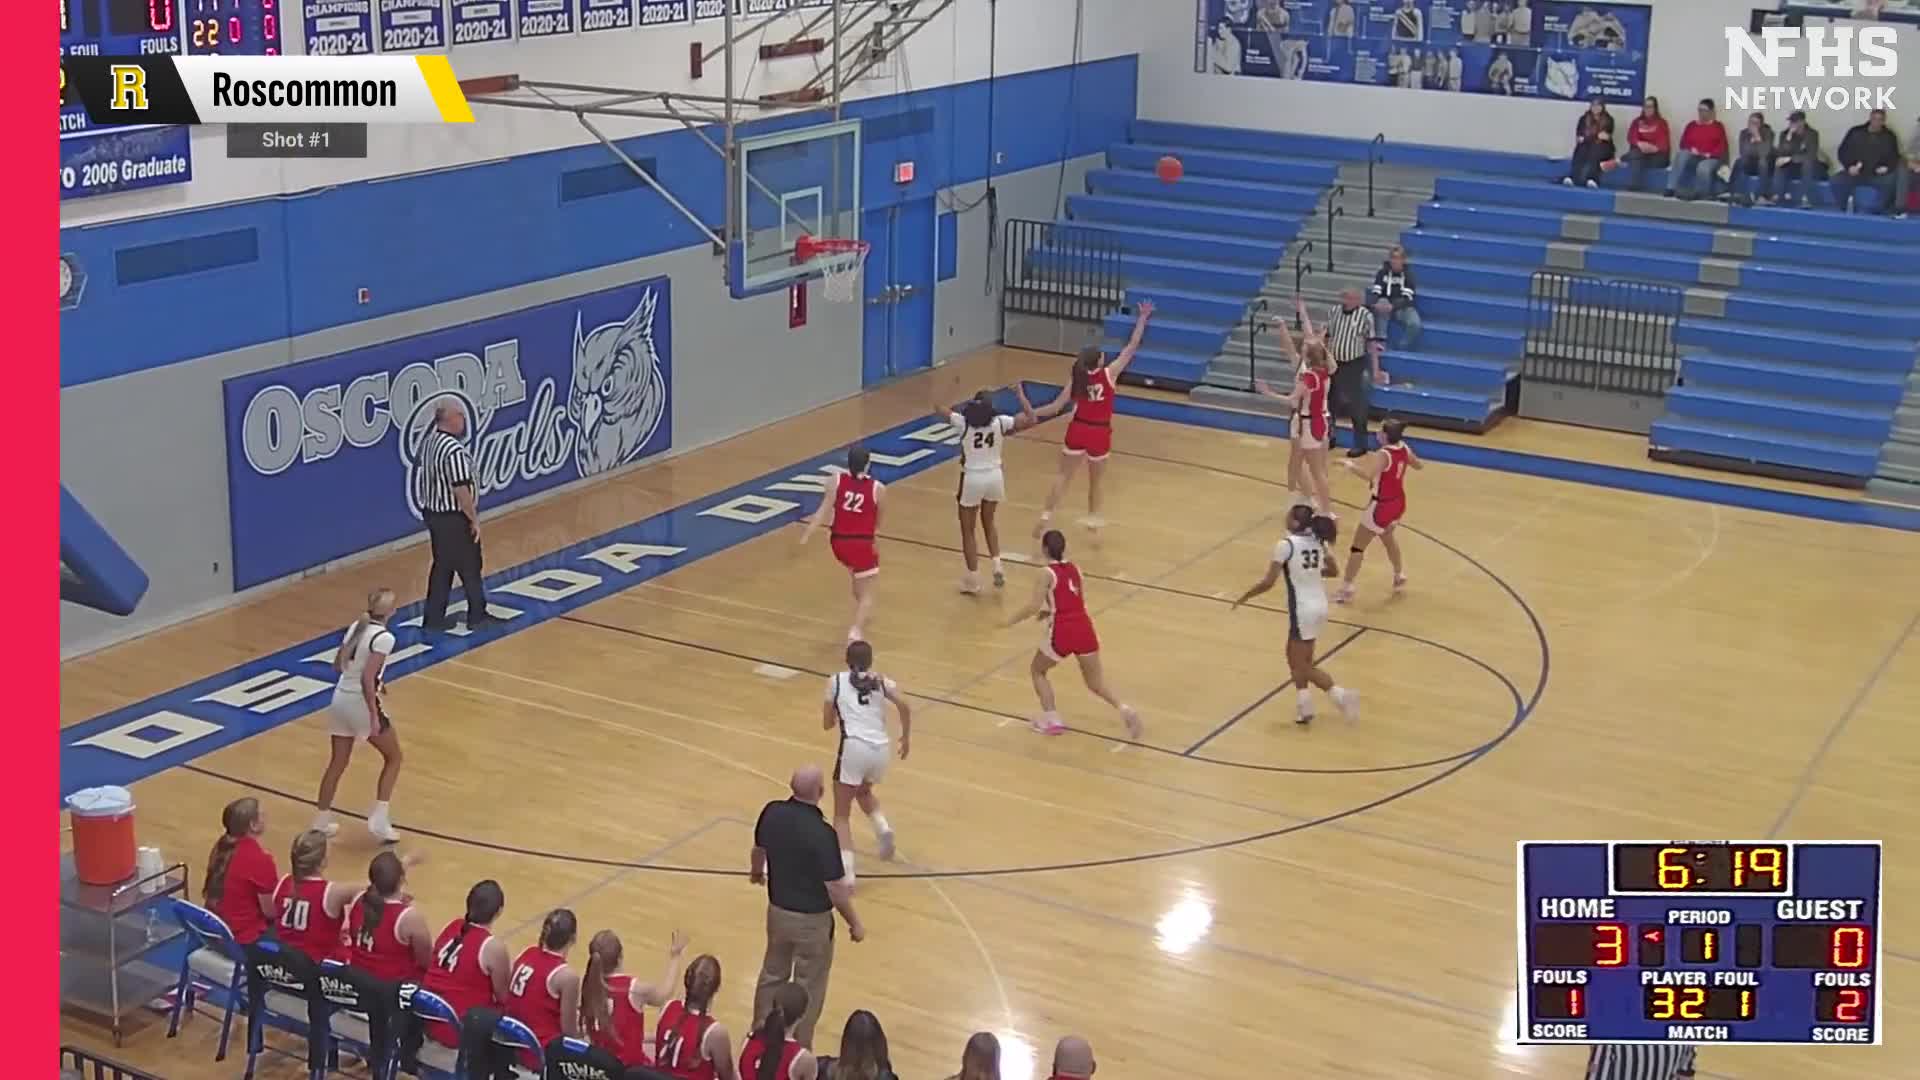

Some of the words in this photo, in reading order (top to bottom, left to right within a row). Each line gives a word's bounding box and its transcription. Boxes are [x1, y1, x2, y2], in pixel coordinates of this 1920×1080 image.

[305, 1, 369, 18] CHAMPIONS
[584, 7, 629, 30] 2020-21
[642, 5, 685, 24] 2020-21
[455, 18, 507, 42] 2020-21
[521, 13, 569, 34] 2020-21
[140, 37, 178, 55] FOULS
[309, 32, 369, 55] 2020-21
[384, 25, 440, 50] 2020-21
[60, 113, 86, 130] TCH
[81, 161, 118, 187] 2006
[122, 154, 187, 181] Graduate
[973, 431, 995, 450] 24
[842, 491, 866, 513] 22
[1302, 549, 1319, 569] 33
[281, 898, 310, 932] 20
[510, 963, 535, 998] 13
